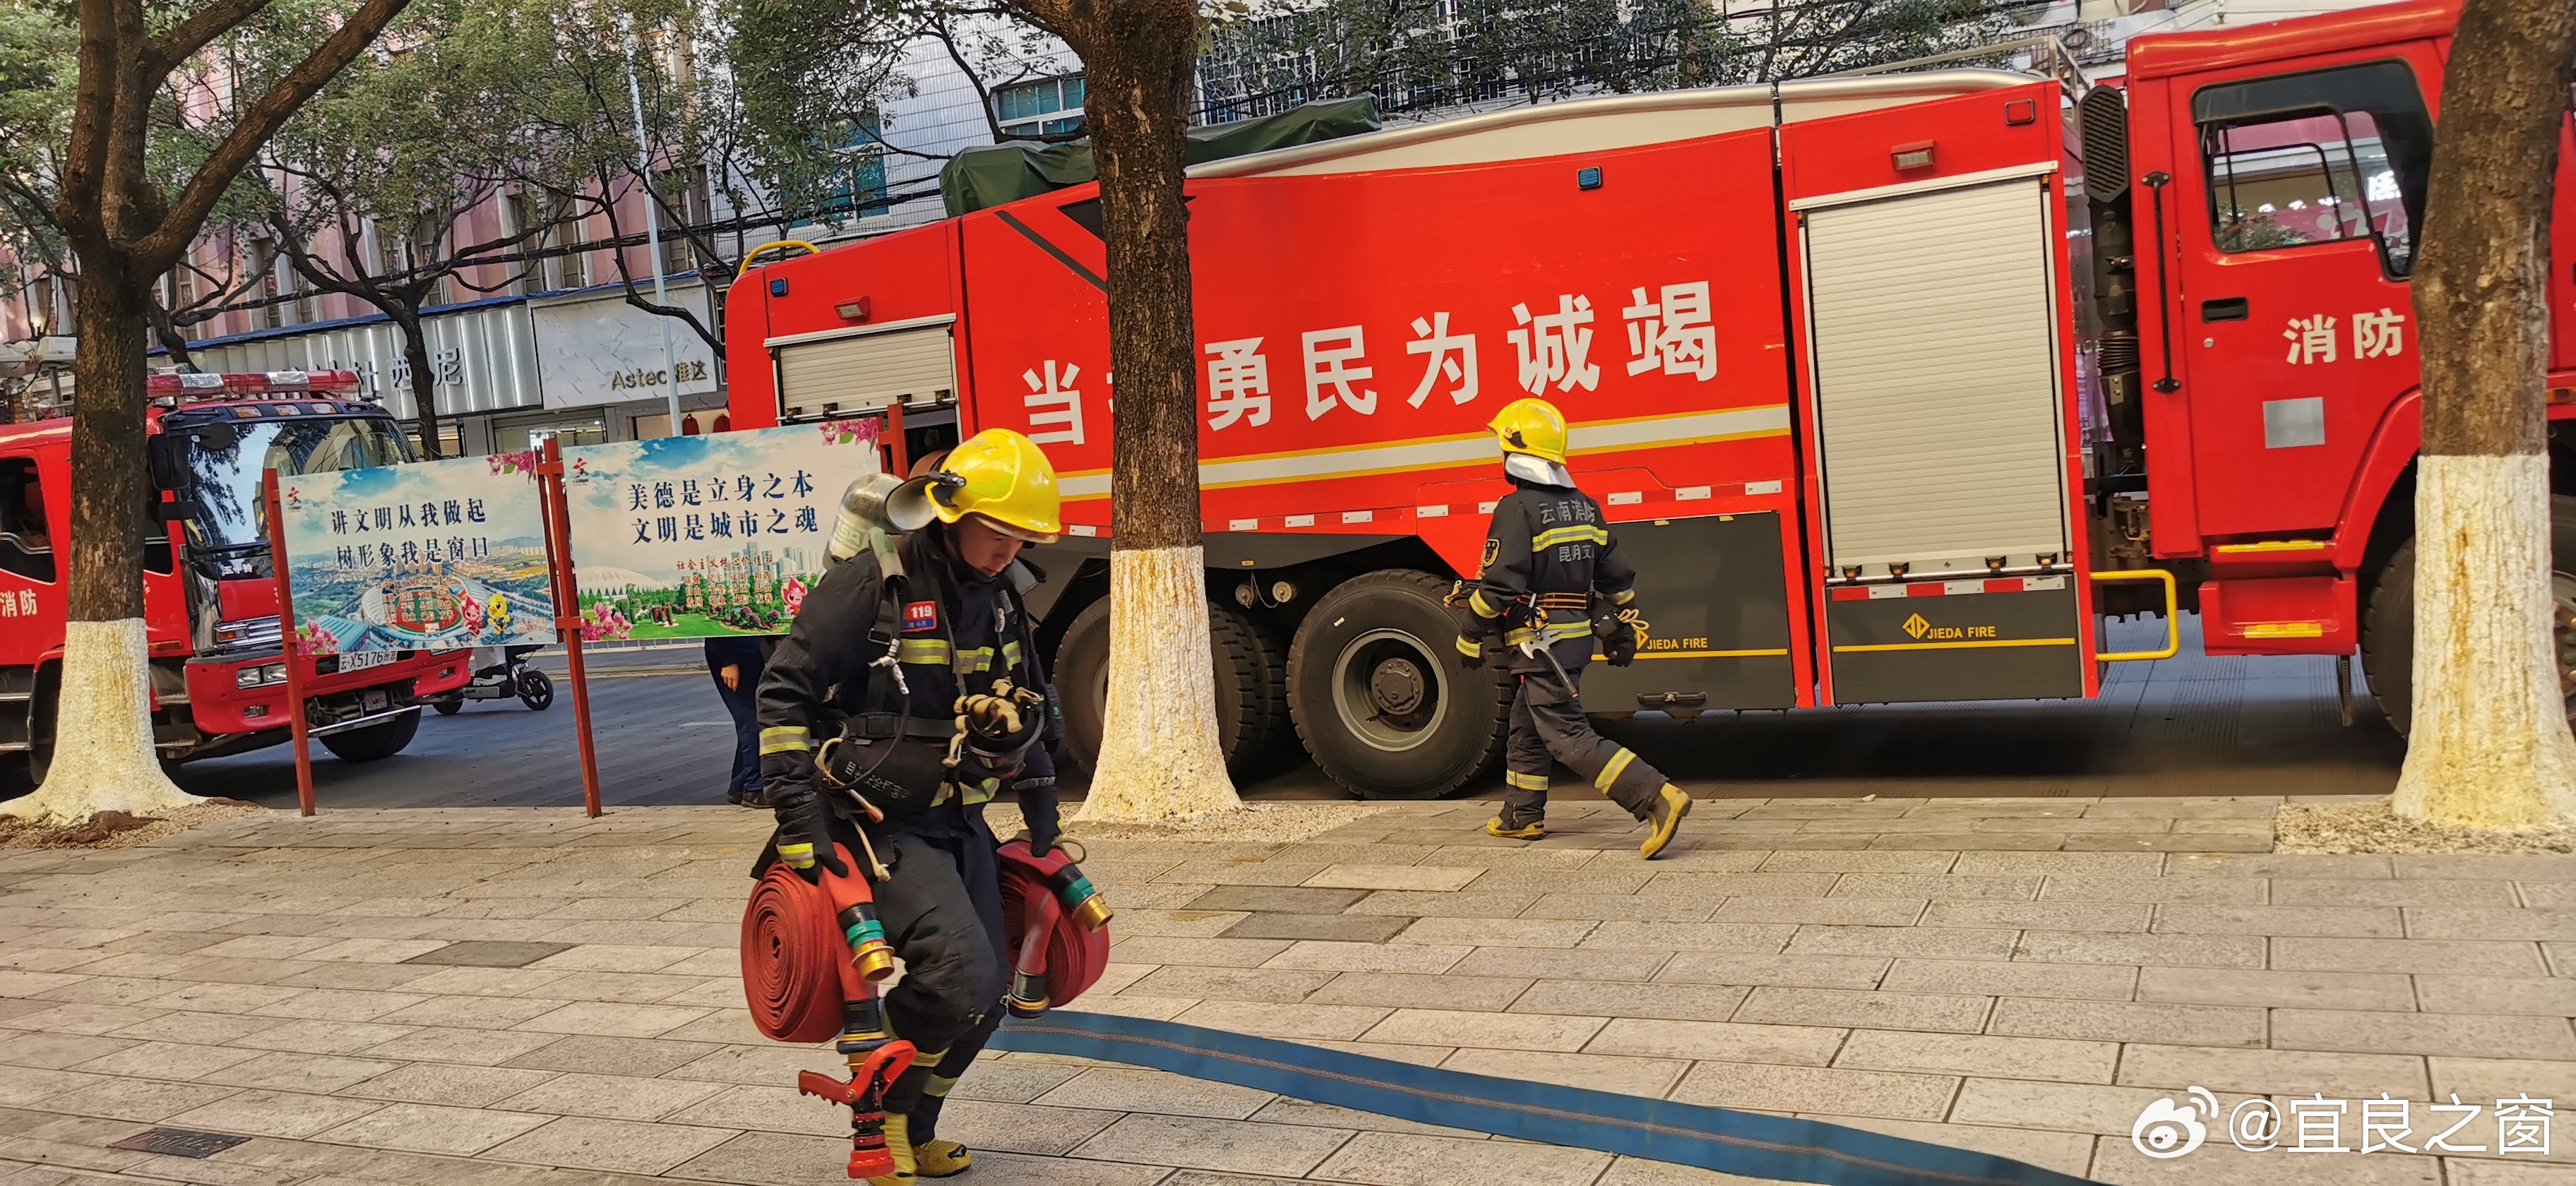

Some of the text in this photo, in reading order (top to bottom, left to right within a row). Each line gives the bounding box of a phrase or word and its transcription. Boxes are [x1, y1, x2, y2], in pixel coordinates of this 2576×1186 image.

[2283, 308, 2404, 365] 消防
[612, 368, 667, 390] Astec
[628, 470, 813, 511] 美德是立身之本
[331, 498, 487, 536] 讲文明从我做起
[631, 505, 819, 545] 文明是城市之魂
[337, 537, 489, 570] 树形象我是窗口
[221, 563, 253, 576] 五十铃
[0, 588, 37, 618] 消防
[910, 605, 932, 618] 119
[1647, 637, 1708, 650] JIEDA FIRE
[1927, 625, 1996, 639] JIEDA FIRE
